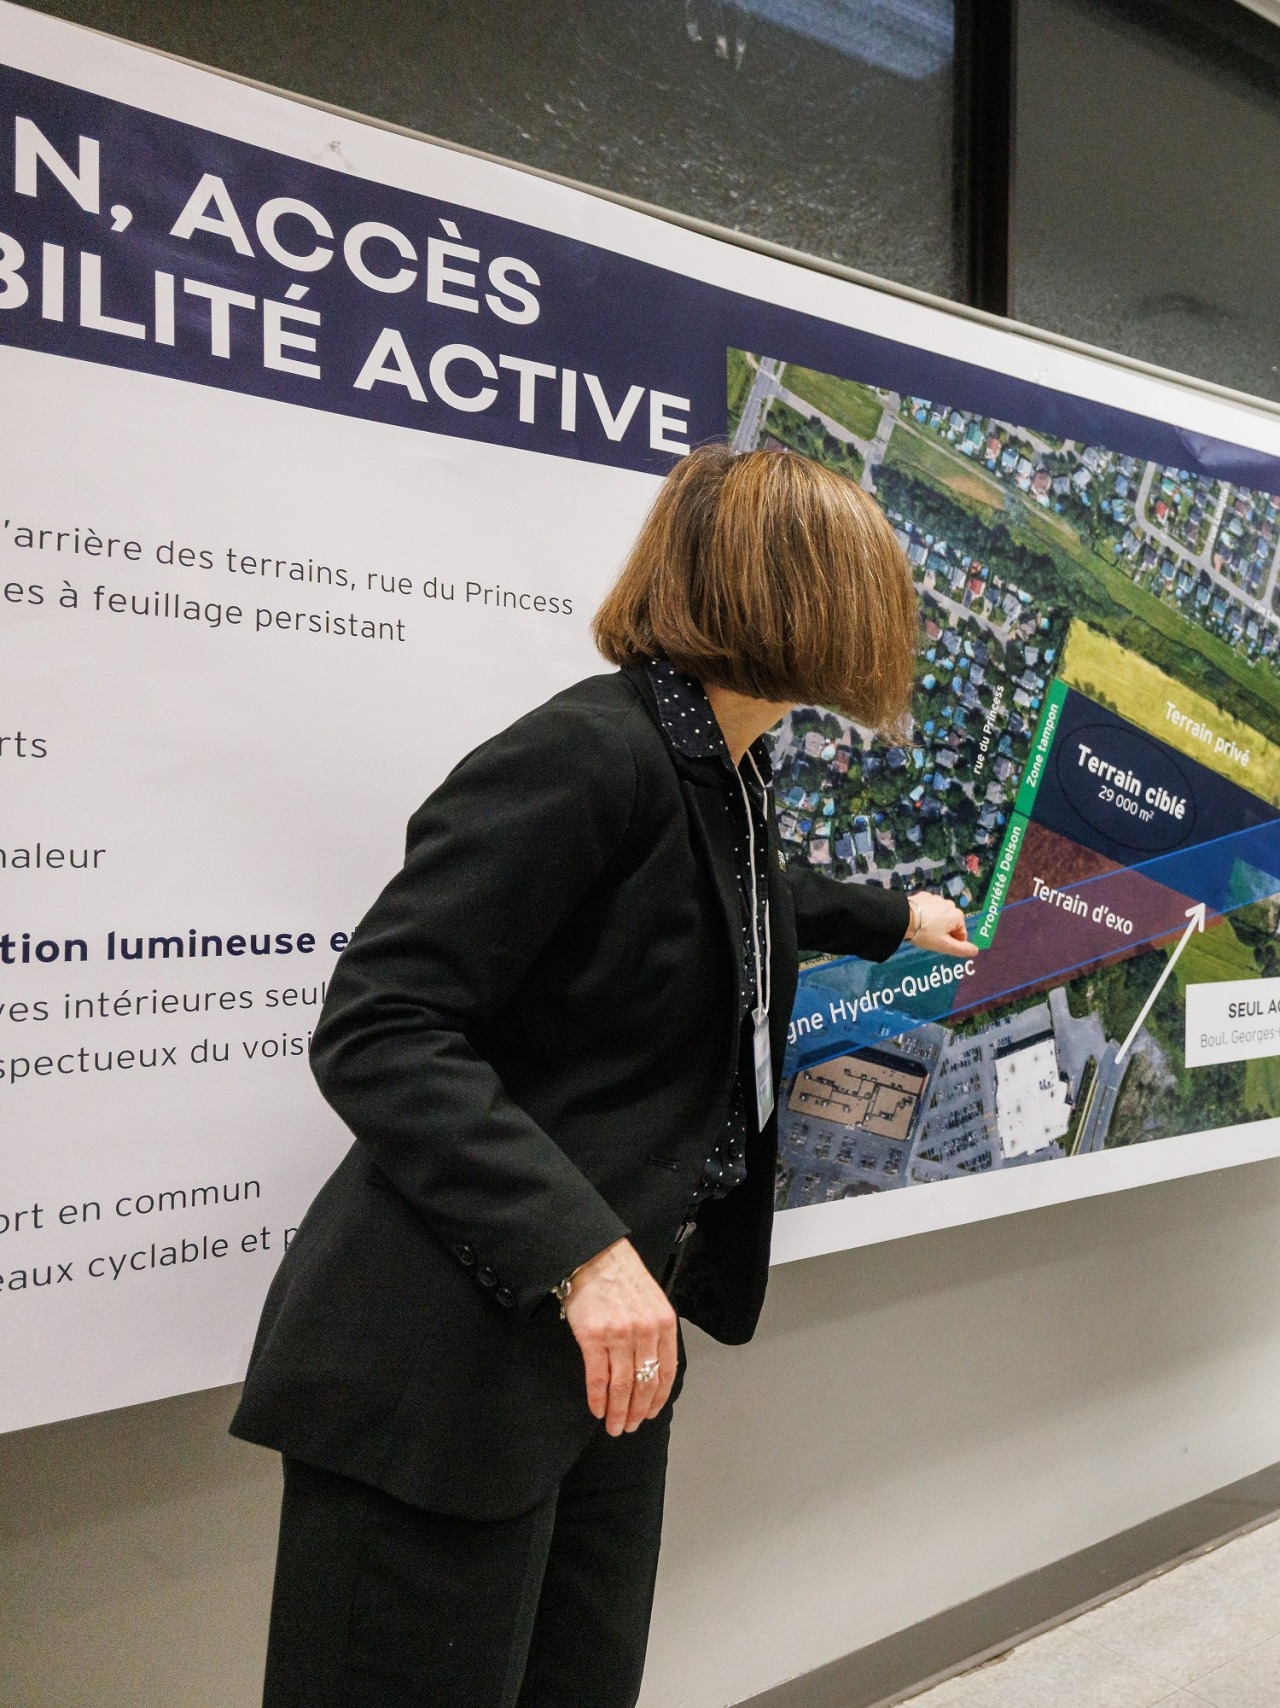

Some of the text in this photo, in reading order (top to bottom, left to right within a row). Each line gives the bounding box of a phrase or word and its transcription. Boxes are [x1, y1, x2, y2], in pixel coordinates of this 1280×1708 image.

[14, 116, 541, 326] N, ACCÈS
[354, 328, 691, 456] ACTIVE
[4, 519, 574, 617] 'arrière des terrains, rue du Princess
[3, 580, 405, 643] es à feuillage persistant
[974, 685, 1005, 775] rue du Princess
[1026, 703, 1060, 788] Zone tampon
[1165, 701, 1250, 767] Terrain privé
[1078, 743, 1188, 820] Terrain ciblé
[1098, 785, 1115, 802] 29
[1115, 794, 1139, 816] 000
[980, 826, 1022, 938] Propriété Delson
[1033, 876, 1133, 935] Terrain d'exo
[107, 928, 316, 961] lumineuse
[330, 926, 357, 954] e
[64, 987, 254, 1020] intérieures
[829, 959, 976, 1024] Hydro-Québec
[1228, 1001, 1264, 1019] SEUL
[190, 1038, 230, 1063] du
[1200, 1032, 1228, 1048] Boul.
[58, 1200, 101, 1226] en
[115, 1179, 261, 1217] commun
[0, 1261, 73, 1292] aux
[88, 1235, 228, 1281] cyclable
[241, 1225, 271, 1253] et
